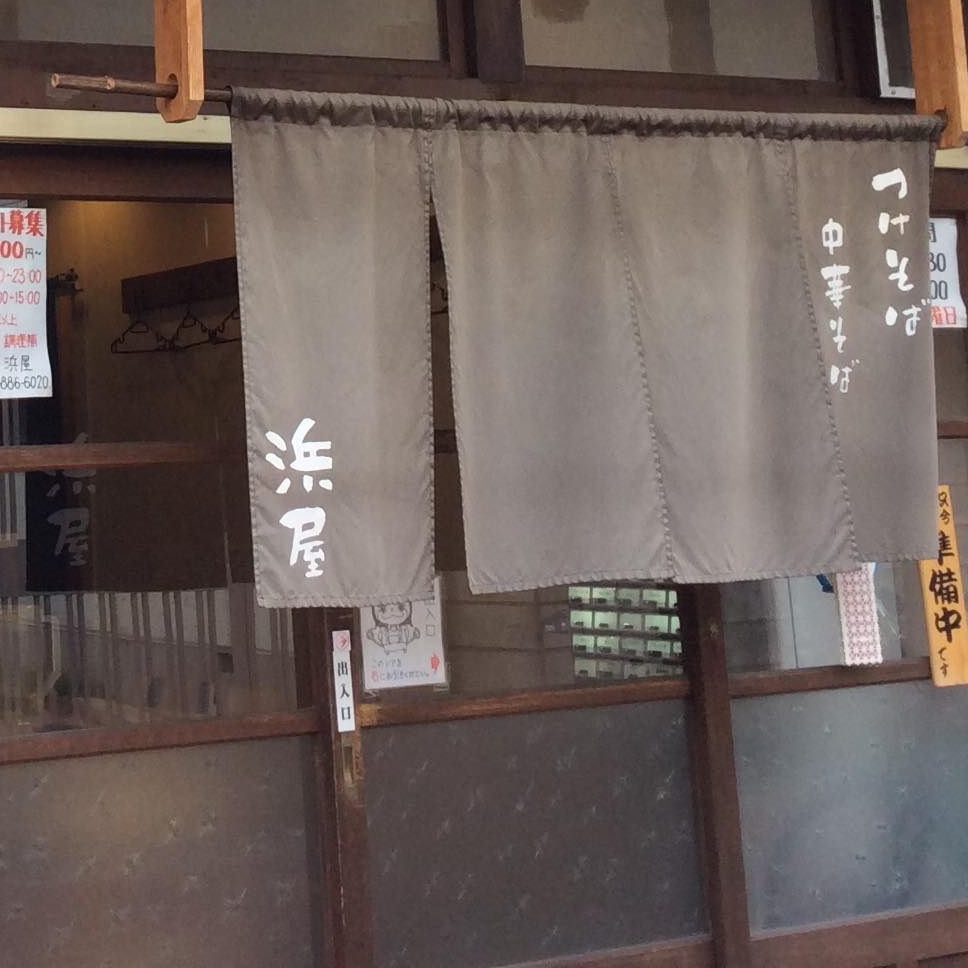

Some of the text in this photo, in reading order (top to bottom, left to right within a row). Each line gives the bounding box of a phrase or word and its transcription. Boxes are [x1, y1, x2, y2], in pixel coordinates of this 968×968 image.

[821, 218, 860, 393] 中華そば
[872, 168, 931, 336] つけそば
[3, 355, 32, 372] 浜屋
[265, 418, 332, 578] 浜屋
[336, 661, 351, 720] 出入口
